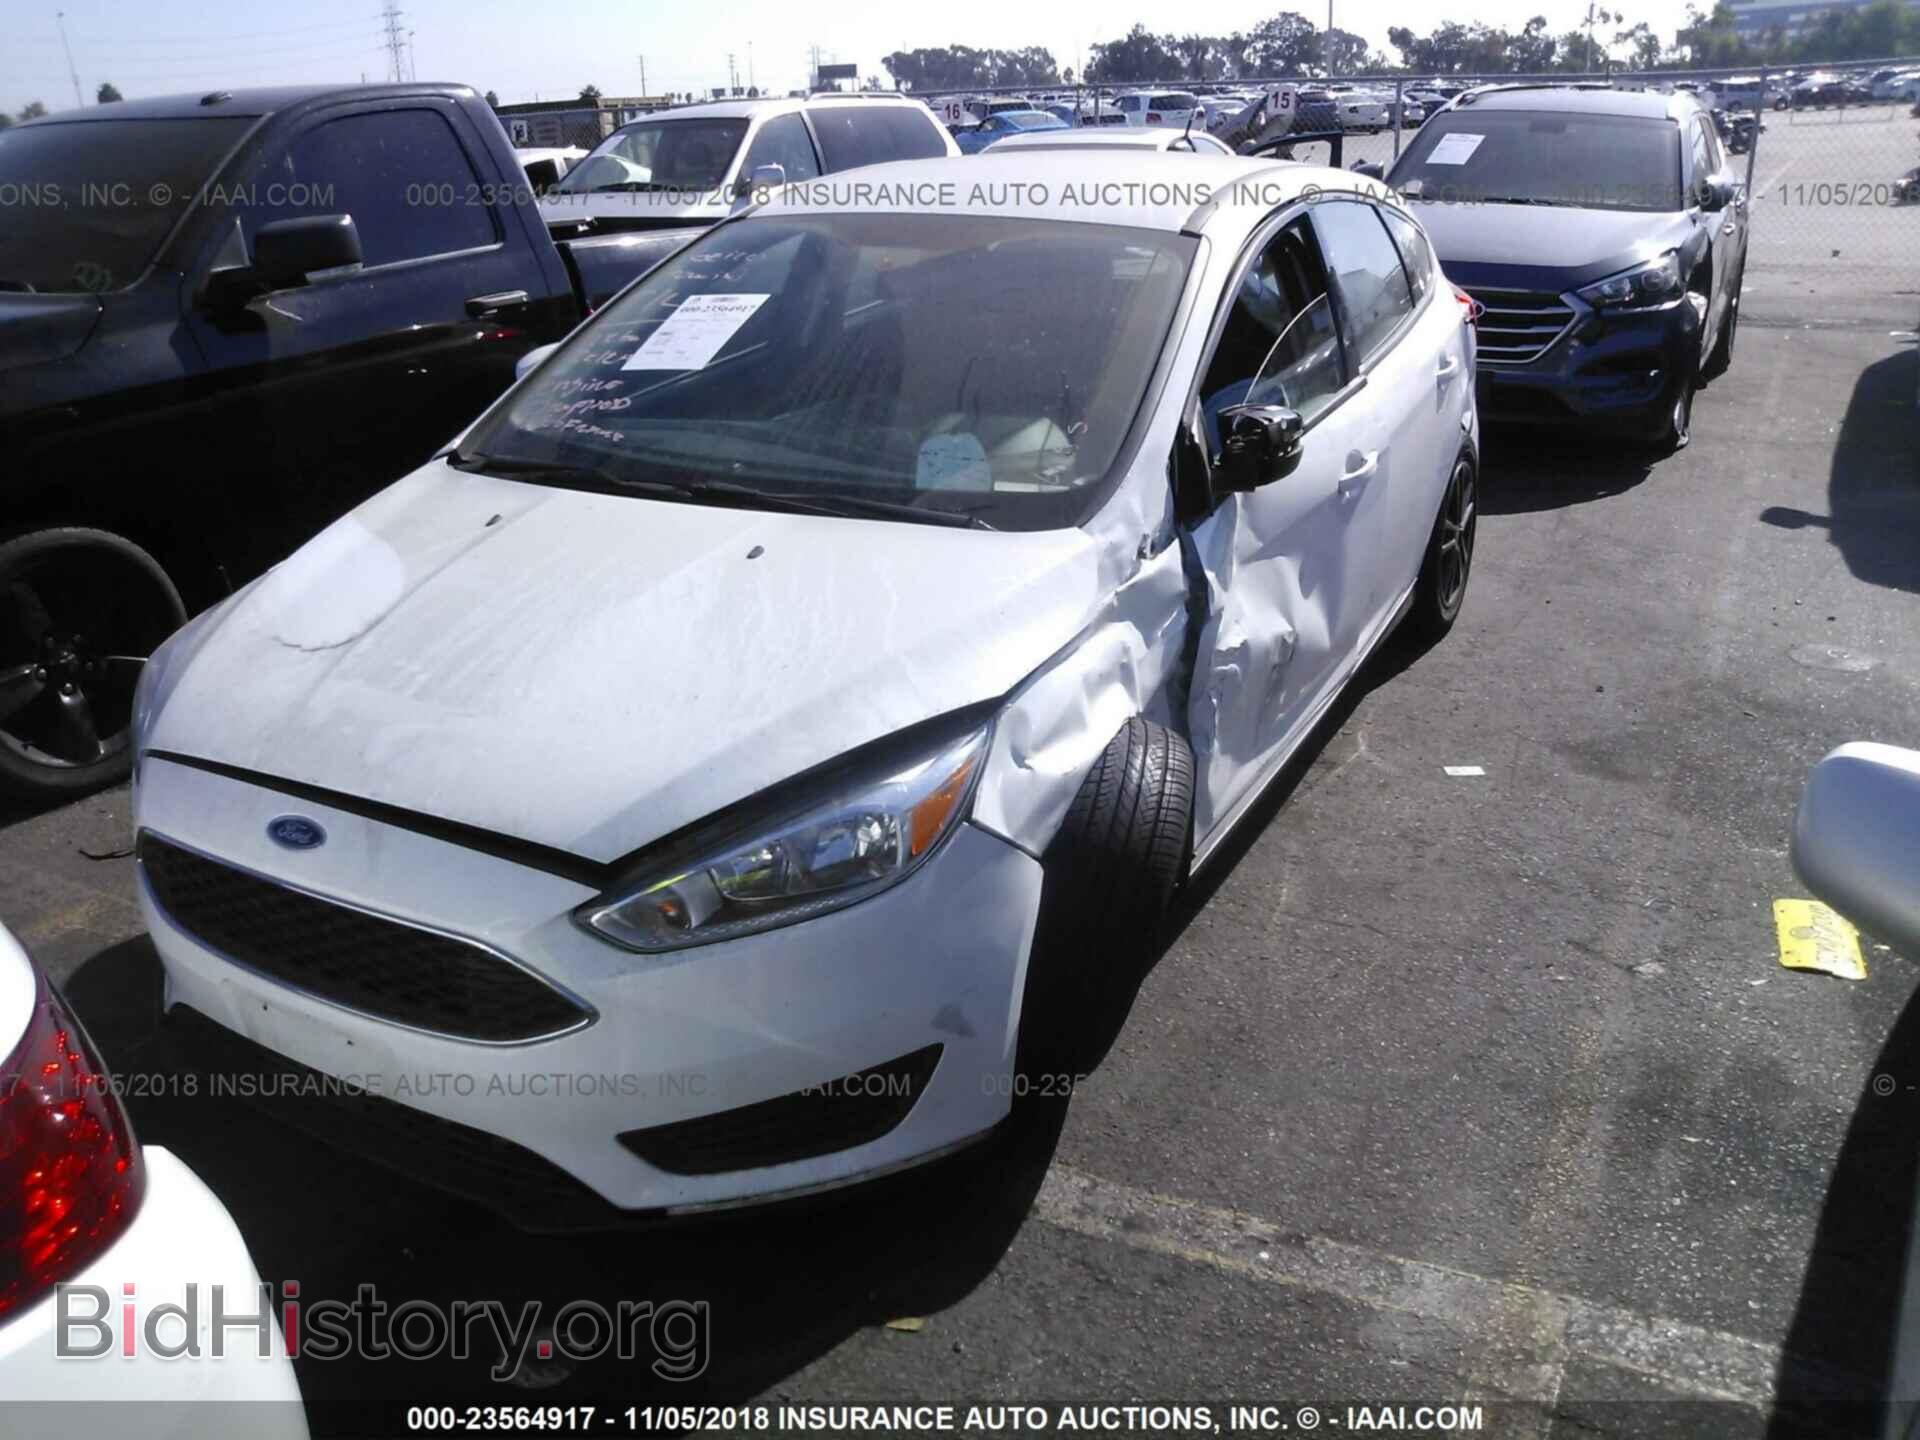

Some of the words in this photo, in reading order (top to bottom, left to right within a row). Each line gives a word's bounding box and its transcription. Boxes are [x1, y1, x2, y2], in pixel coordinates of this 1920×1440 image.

[1272, 92, 1290, 109] 15
[945, 104, 960, 119] 16
[278, 823, 313, 844] Ford
